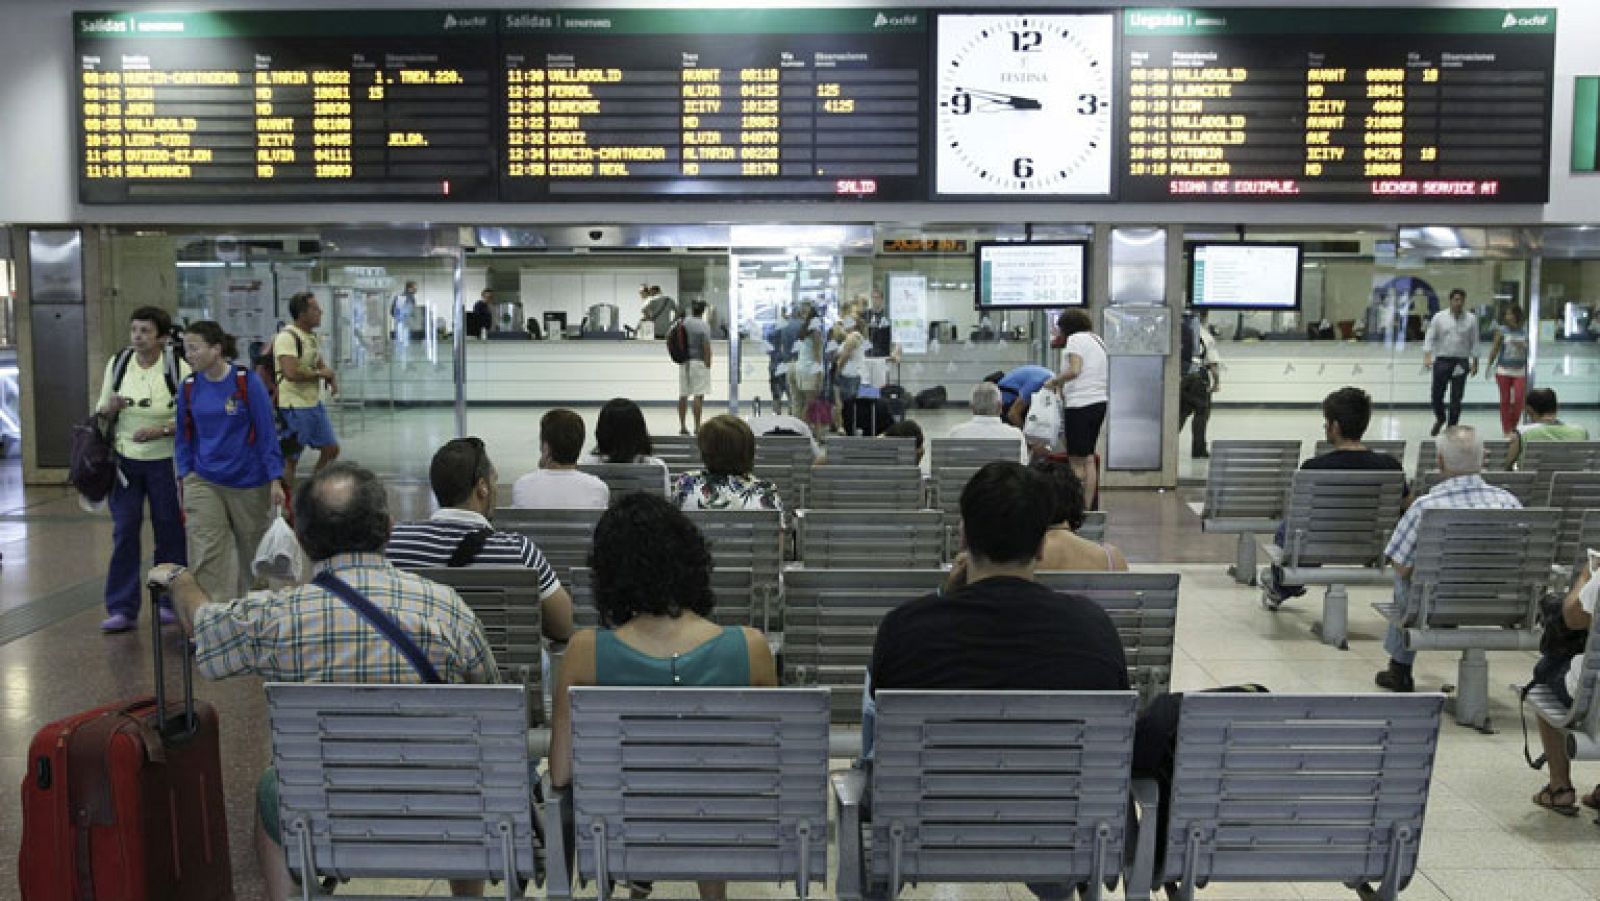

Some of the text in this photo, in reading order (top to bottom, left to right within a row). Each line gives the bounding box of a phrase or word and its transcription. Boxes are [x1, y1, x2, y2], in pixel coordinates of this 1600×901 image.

[506, 15, 552, 28] Salidas
[1009, 31, 1042, 52] 12
[548, 69, 622, 82] VALLADOLID
[683, 69, 721, 82] AVANT
[1172, 69, 1247, 82] VALLADOLID
[1308, 69, 1346, 82] AVANT
[683, 84, 721, 98] ALVIA
[817, 84, 841, 97] 125
[683, 100, 721, 113] ICITY
[951, 94, 972, 115] 9
[1077, 94, 1098, 115] 3
[1308, 100, 1346, 113] ICITY
[125, 118, 197, 131] VALLADOLID
[257, 118, 294, 131] AVANT
[1171, 116, 1246, 129] VALLADOLID
[1306, 116, 1344, 129] AVANT
[258, 133, 295, 146] ICITY
[683, 131, 721, 145] ALVIA
[1171, 131, 1246, 145] VALLADOLID
[258, 149, 295, 162] ALVIA
[549, 147, 666, 160] MURCIA-CARTAGENA
[683, 147, 736, 160] ALTARIA
[1171, 147, 1223, 160] VITORIA
[1307, 147, 1344, 160] ICITY
[600, 162, 630, 176] REAL
[1013, 158, 1035, 178] 6
[1171, 162, 1230, 176] PALENCIA
[836, 181, 876, 194] SALID
[1212, 181, 1228, 194] DE
[1372, 181, 1417, 194] LOCKER
[1422, 181, 1475, 194] SERVICE
[1480, 181, 1498, 194] AT
